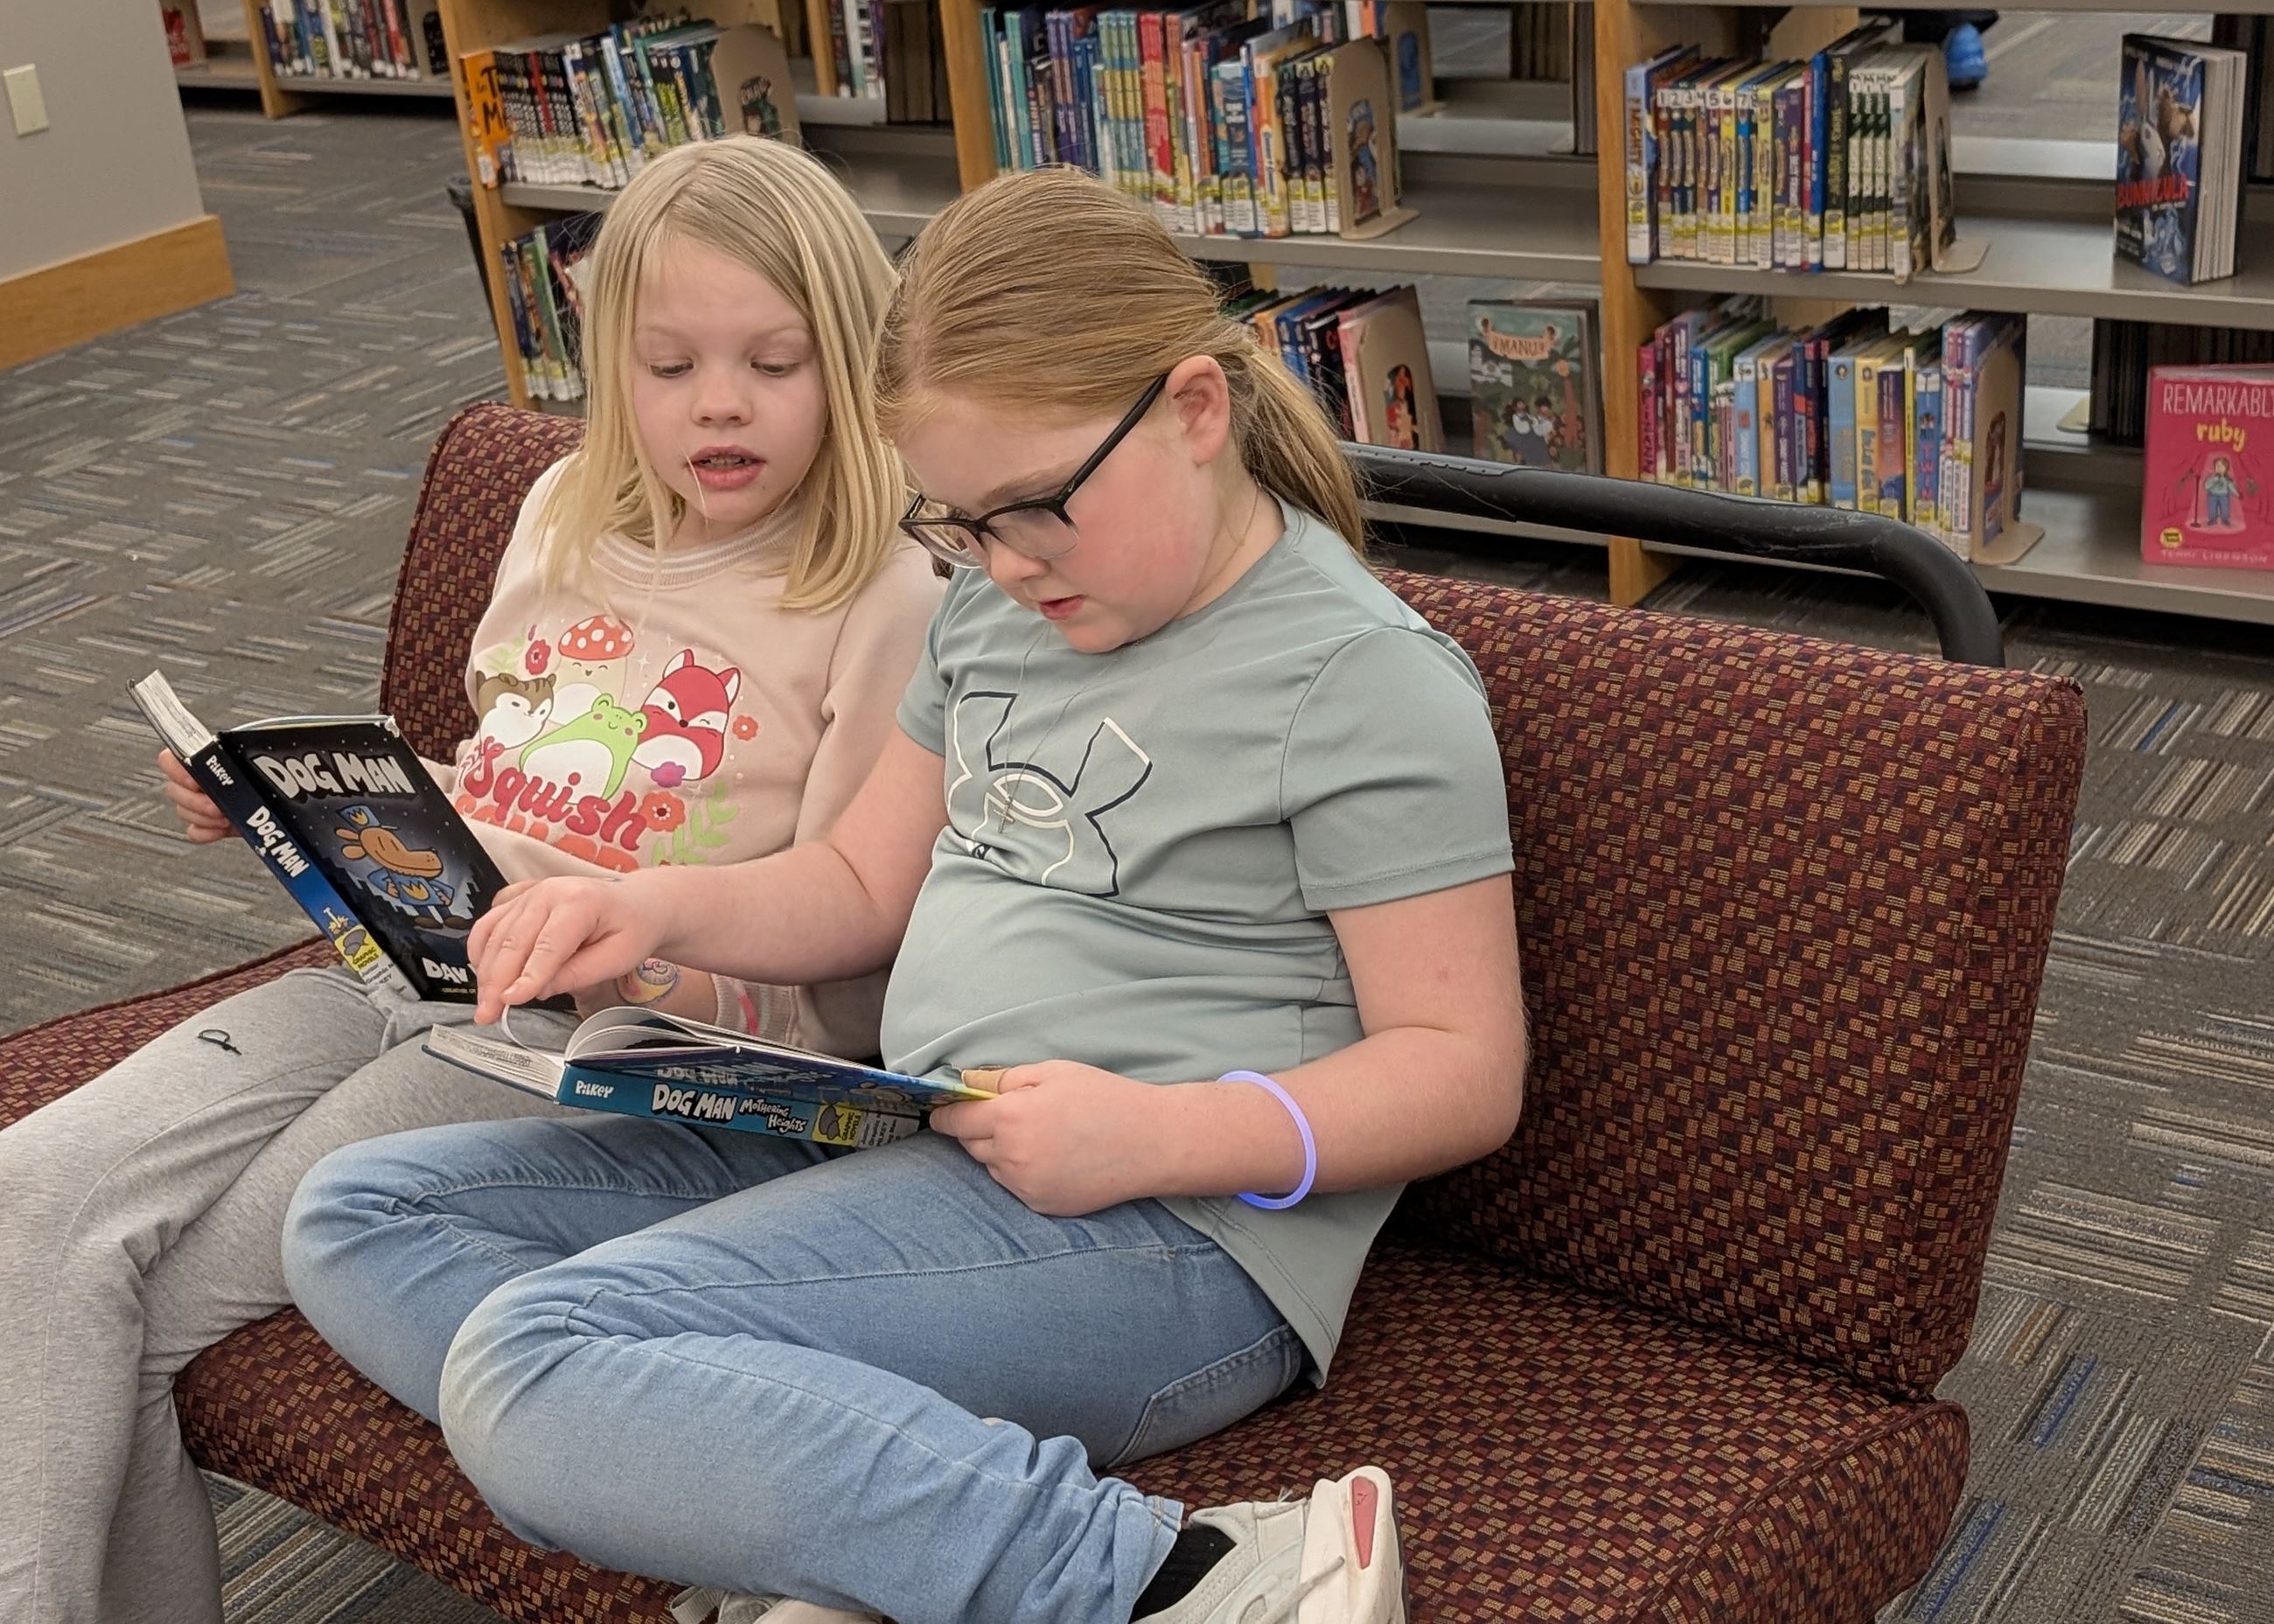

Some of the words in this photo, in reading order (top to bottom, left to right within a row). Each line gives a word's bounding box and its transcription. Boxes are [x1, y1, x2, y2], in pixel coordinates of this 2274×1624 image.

[2196, 417, 2246, 453] ruby
[253, 753, 345, 799] DOG
[332, 752, 416, 794] MAN
[464, 736, 647, 852] Squish
[246, 805, 286, 848] DOG
[270, 840, 310, 878] MAN
[422, 957, 469, 985] DAV
[652, 1084, 694, 1118] DOG
[693, 1093, 737, 1120] MAN
